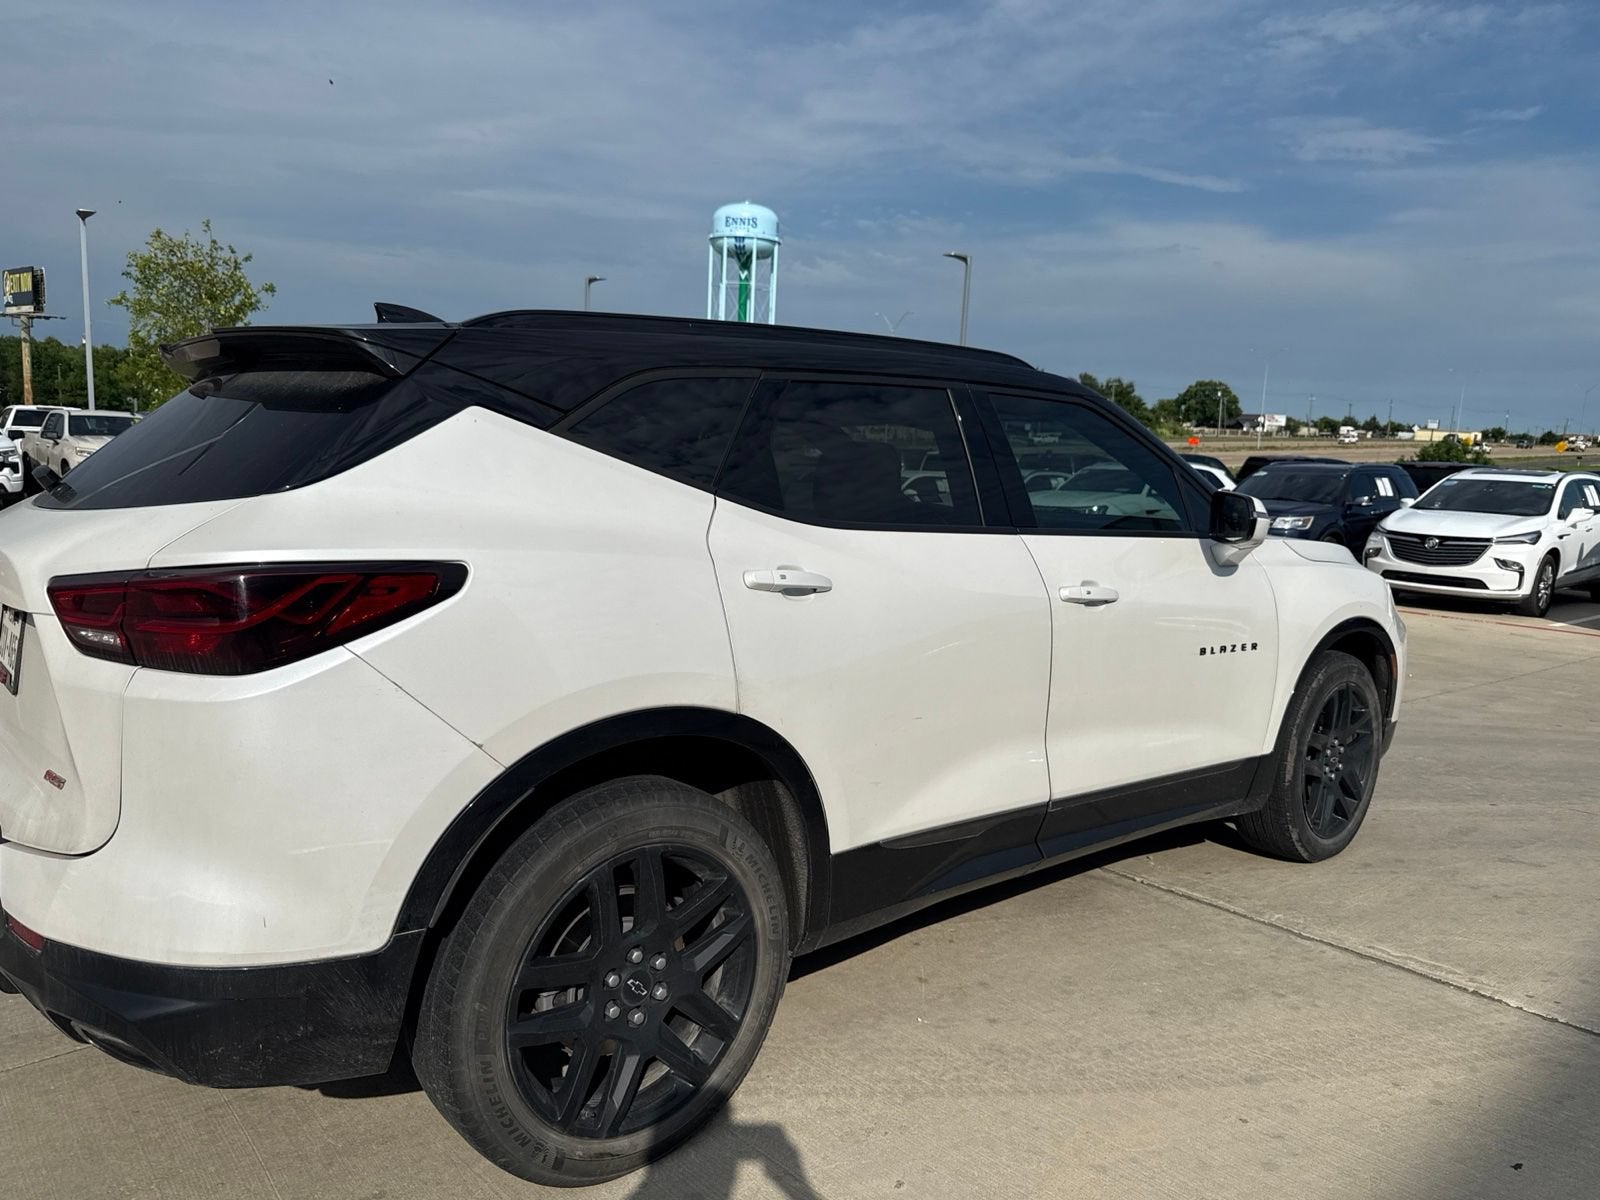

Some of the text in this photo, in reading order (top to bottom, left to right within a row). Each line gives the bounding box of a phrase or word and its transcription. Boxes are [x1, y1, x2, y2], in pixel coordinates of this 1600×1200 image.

[725, 216, 758, 229] ENNIS
[1199, 642, 1258, 656] BLAZER
[745, 853, 779, 936] MICHELIN
[479, 1060, 532, 1149] MICHELIN
